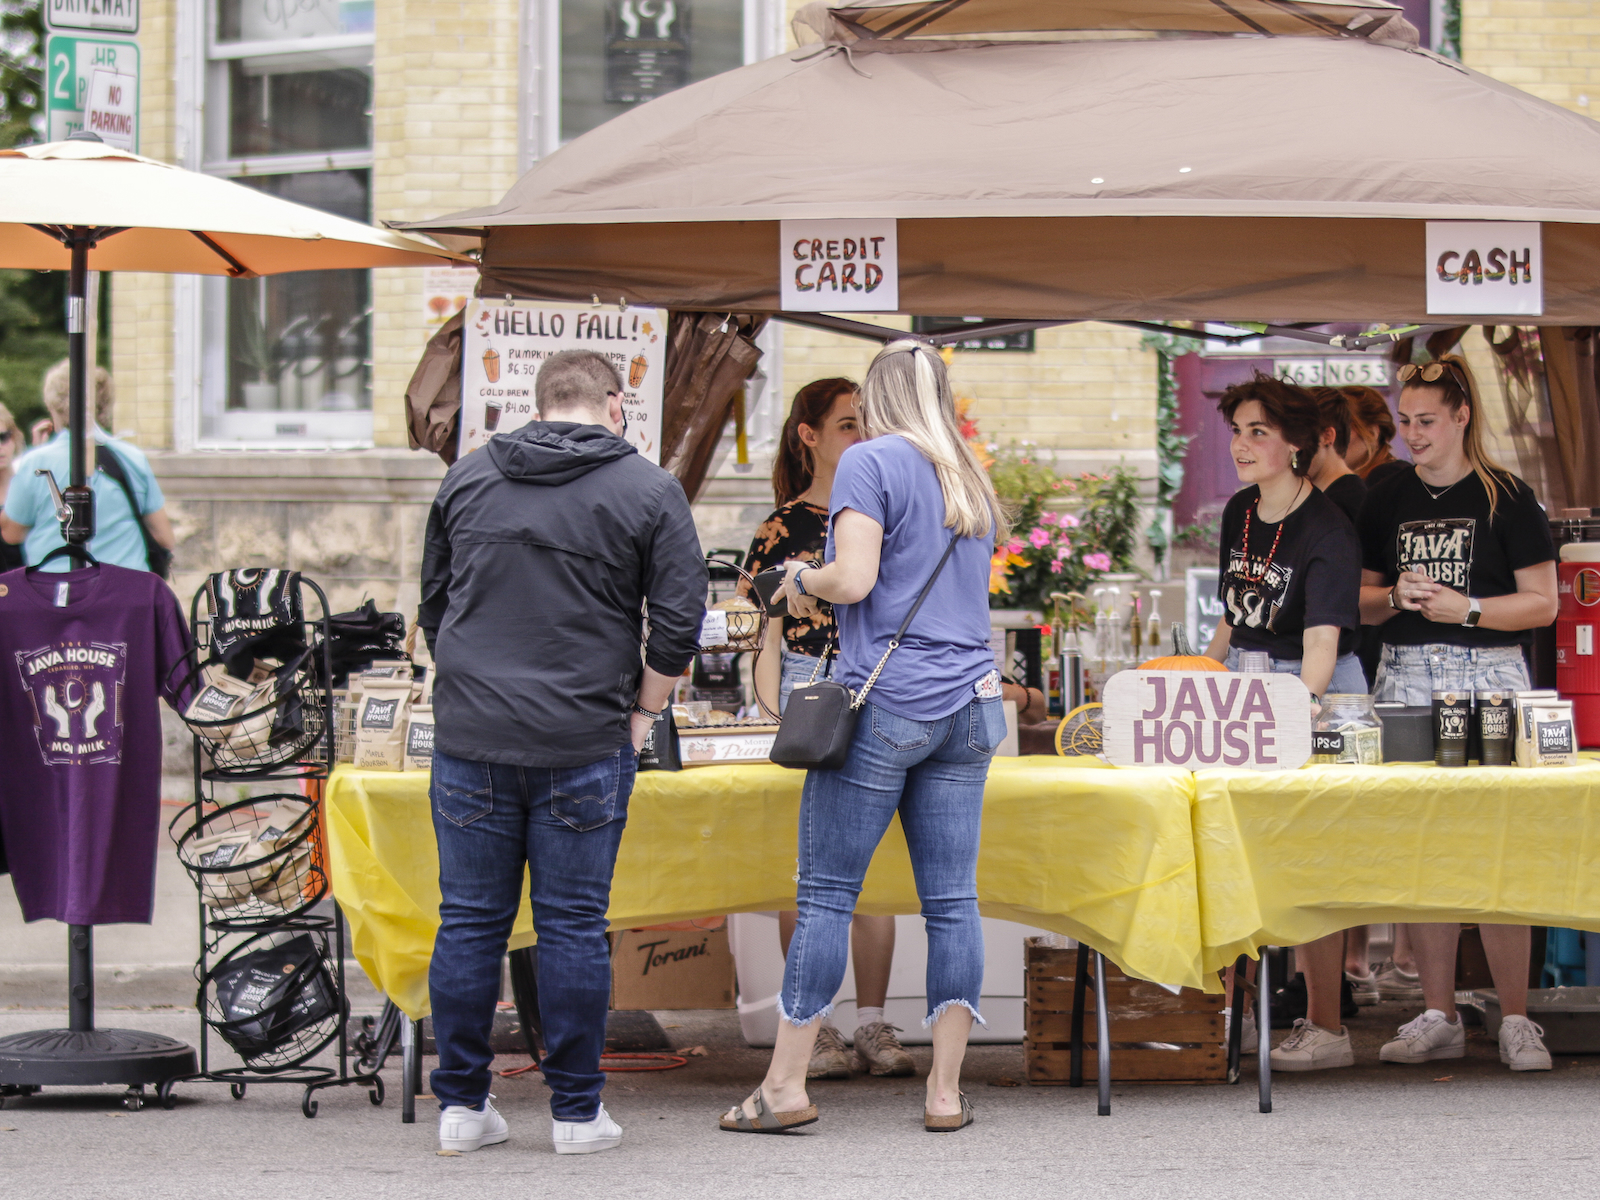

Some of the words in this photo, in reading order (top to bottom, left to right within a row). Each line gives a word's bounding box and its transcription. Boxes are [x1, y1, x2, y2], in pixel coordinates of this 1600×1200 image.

[96, 47, 117, 67] HR
[54, 53, 70, 99] 2
[108, 85, 121, 106] NO
[90, 110, 132, 135] PARKING
[793, 236, 885, 262] CREDIT
[1436, 247, 1532, 287] CASH
[795, 261, 884, 294] CARD
[494, 308, 565, 338] HELLO
[575, 312, 639, 342] FALL!
[507, 362, 536, 376] $6.50
[1328, 363, 1387, 383] N653
[480, 388, 504, 397] COLD
[507, 389, 530, 397] BREW
[505, 401, 531, 414] $4.00
[1400, 528, 1470, 564] JAVA
[251, 616, 277, 630] MILK
[28, 650, 65, 676] JAVA
[66, 647, 117, 668] HOUSE
[1142, 676, 1276, 722] JAVA
[366, 713, 391, 722] HOUSE
[368, 703, 395, 716] JAVA
[1481, 711, 1508, 724] JAVA
[1482, 723, 1508, 735] HOUSE
[1541, 725, 1567, 738] JAVA
[77, 740, 106, 755] MILK
[1133, 718, 1279, 767] HOUSE
[1542, 737, 1569, 747] HOUSE
[637, 937, 709, 976] Torani
